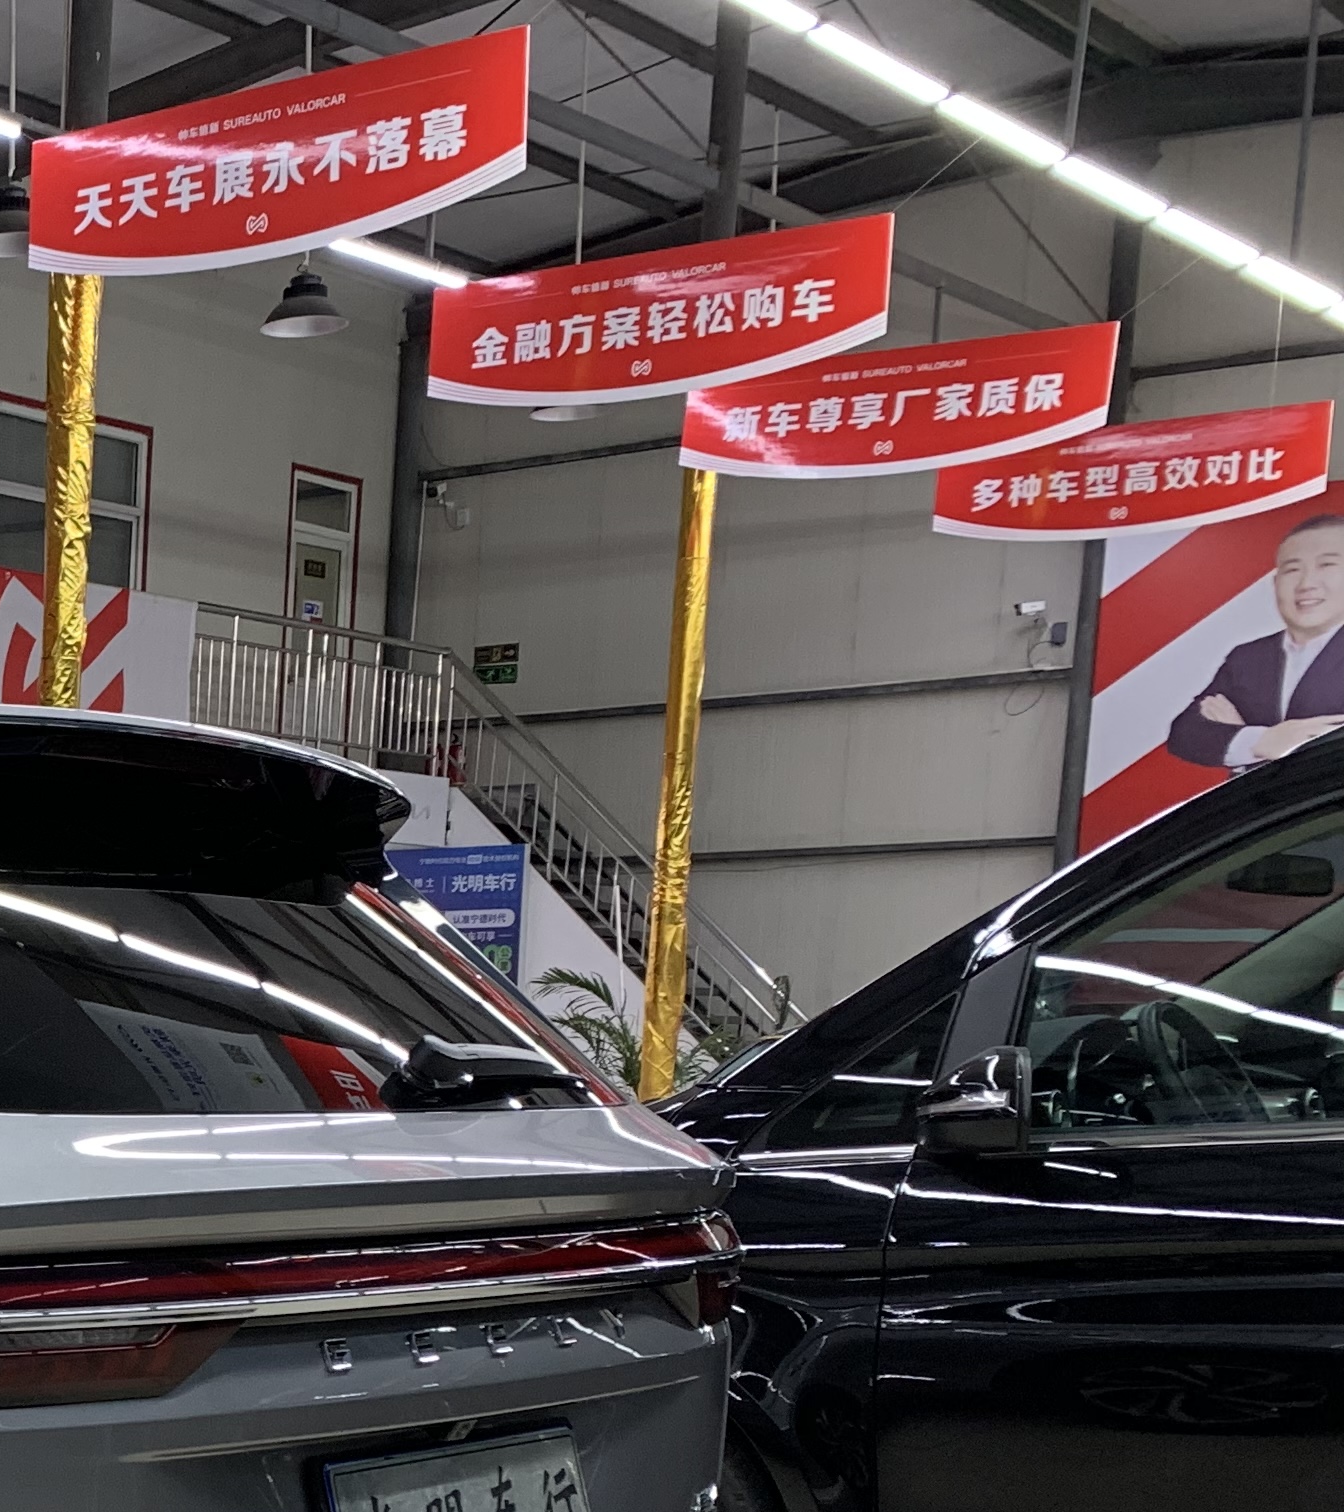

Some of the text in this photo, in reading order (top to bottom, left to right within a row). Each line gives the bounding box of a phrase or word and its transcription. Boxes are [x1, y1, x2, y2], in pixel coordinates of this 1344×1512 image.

[223, 108, 282, 131] SUREAUTO
[286, 93, 347, 117] VALORCAR
[74, 104, 468, 236] 天天车展永不落幕
[471, 278, 837, 370] 金融方案轻松购车
[723, 372, 1066, 443] 新车尊享厂家质保
[970, 447, 1286, 513] 多种车型高效对比
[451, 873, 517, 893] 光明车行
